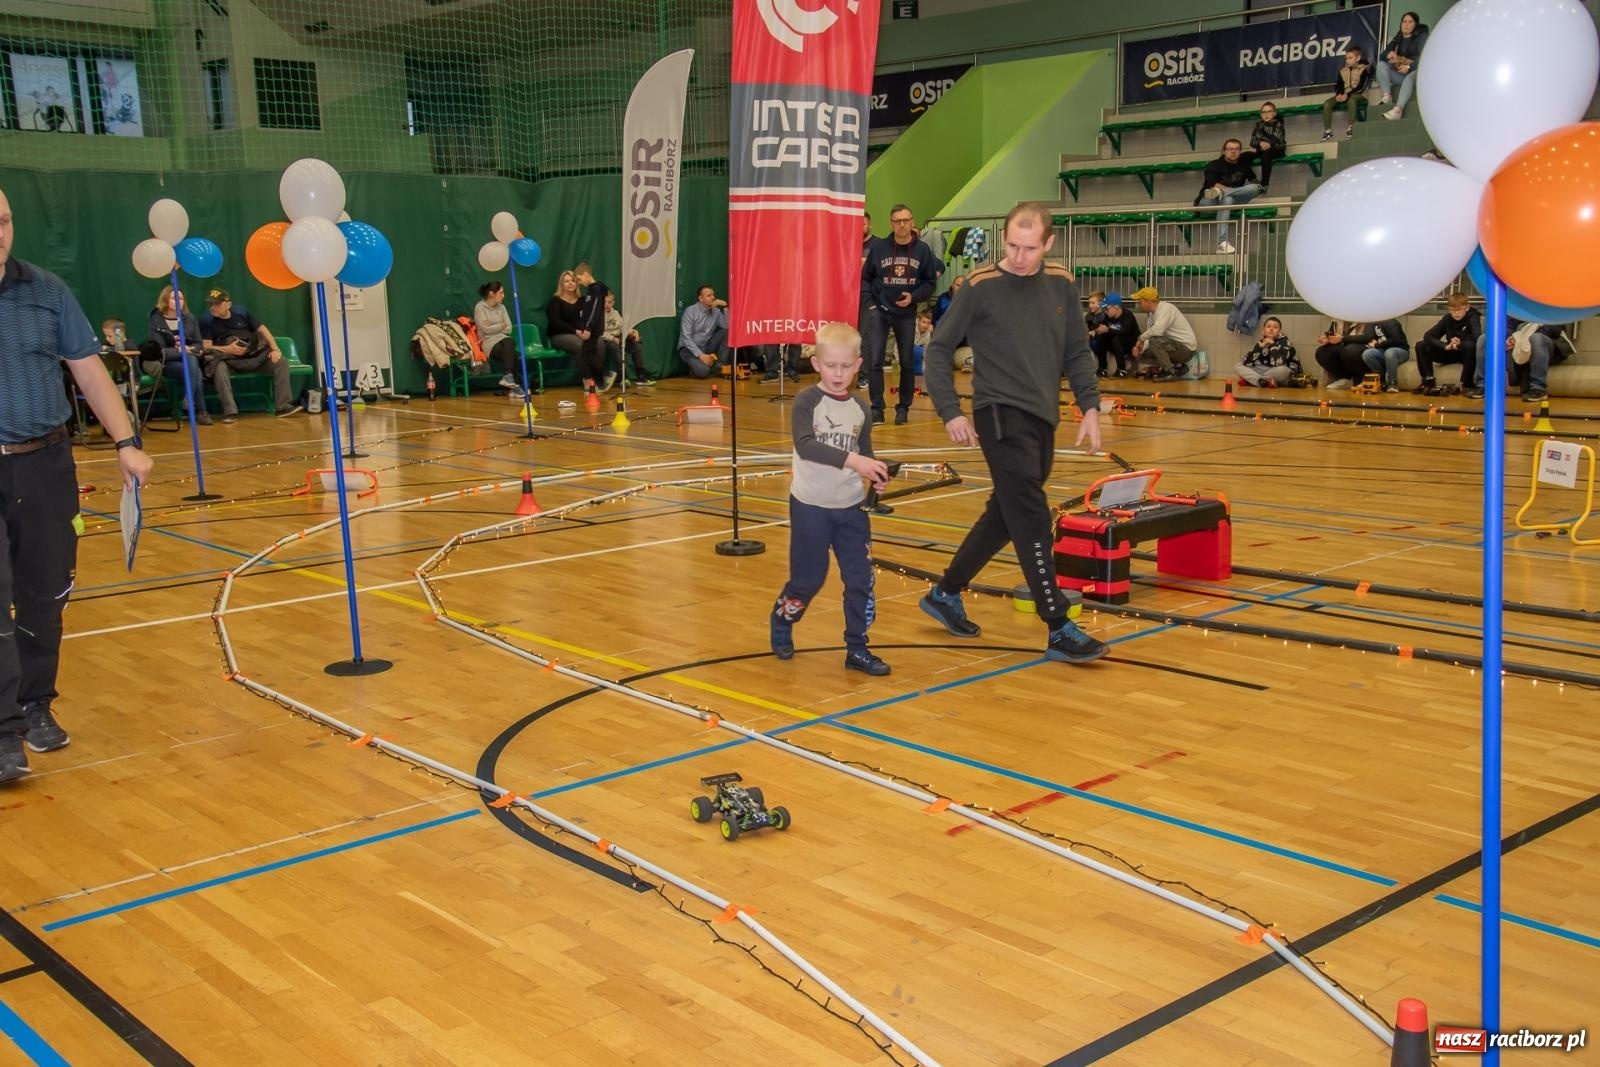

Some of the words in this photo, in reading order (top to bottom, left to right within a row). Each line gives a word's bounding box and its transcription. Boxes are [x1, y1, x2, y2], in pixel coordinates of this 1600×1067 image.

[1144, 47, 1204, 78] OSiR
[1239, 34, 1352, 69] RACIBÓRZ
[1166, 73, 1205, 86] RACIBÓRZ
[752, 99, 860, 139] INTER
[751, 136, 860, 174] CARS
[663, 138, 677, 212] RACIBÓRZ
[629, 137, 664, 259] OSiR
[369, 364, 379, 379] 3
